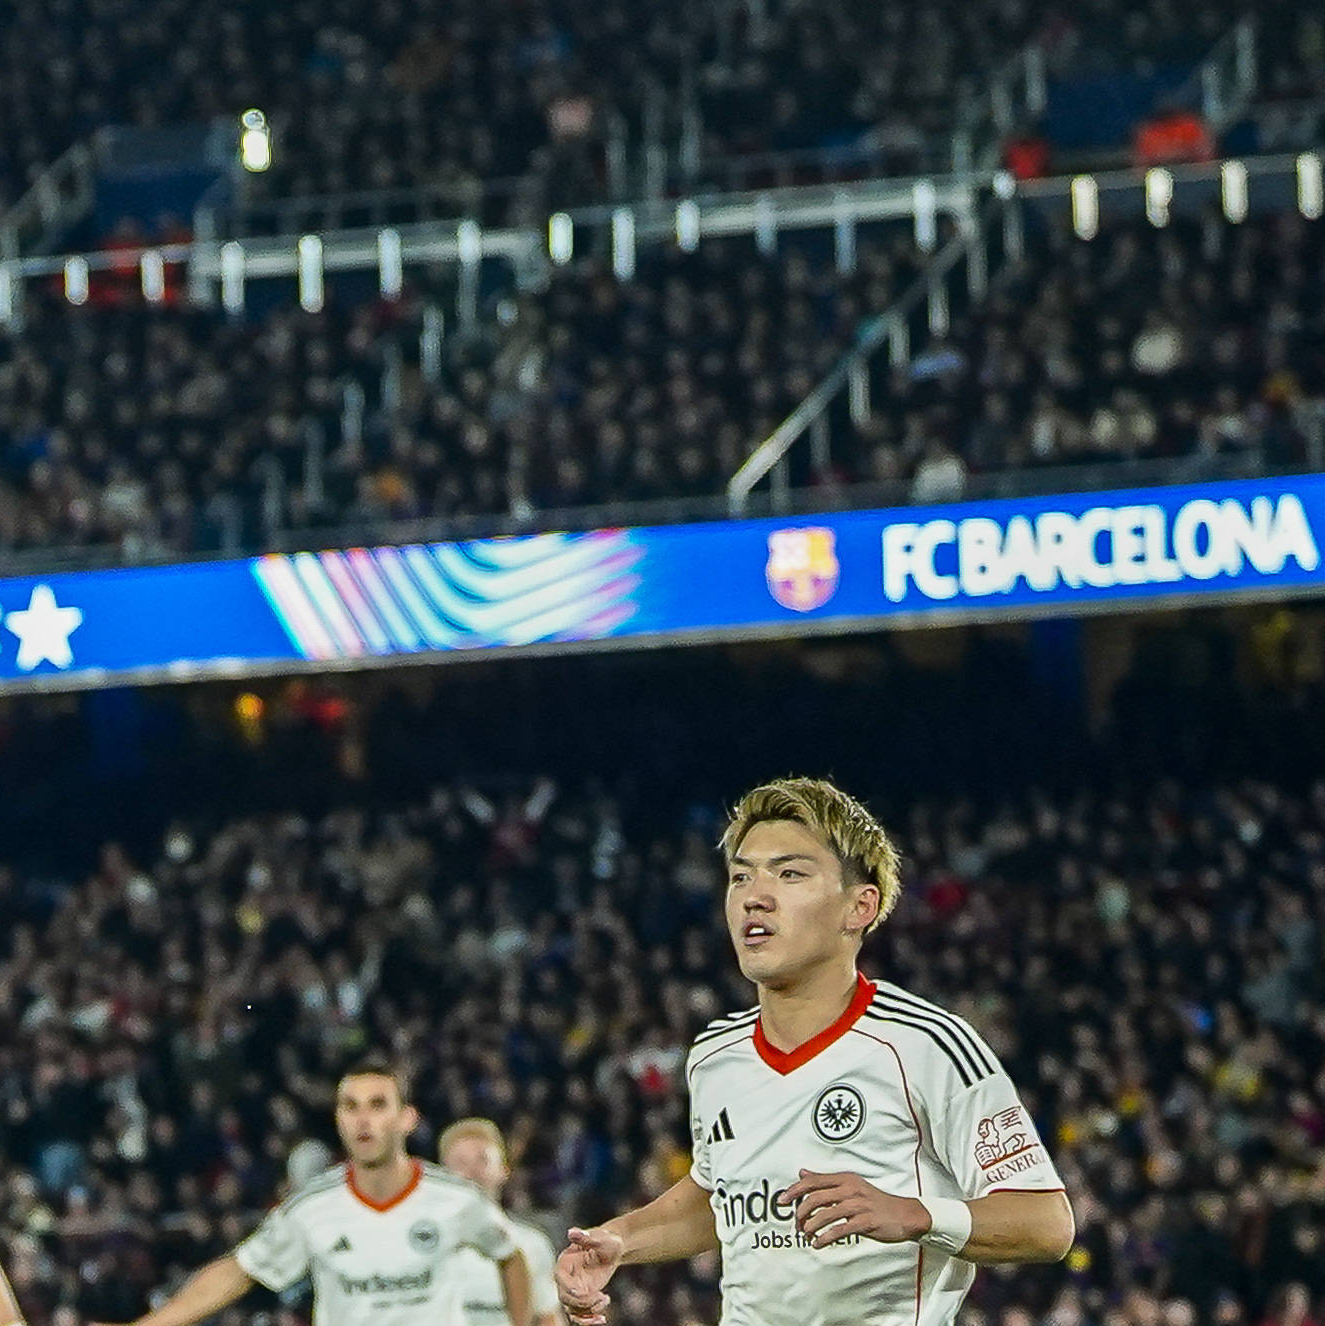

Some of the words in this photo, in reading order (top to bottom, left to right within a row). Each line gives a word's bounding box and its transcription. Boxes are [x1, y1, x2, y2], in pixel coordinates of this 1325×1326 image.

[882, 519, 959, 603] FC
[958, 493, 1320, 598] BARCELONA
[751, 1230, 792, 1250] Jobs
